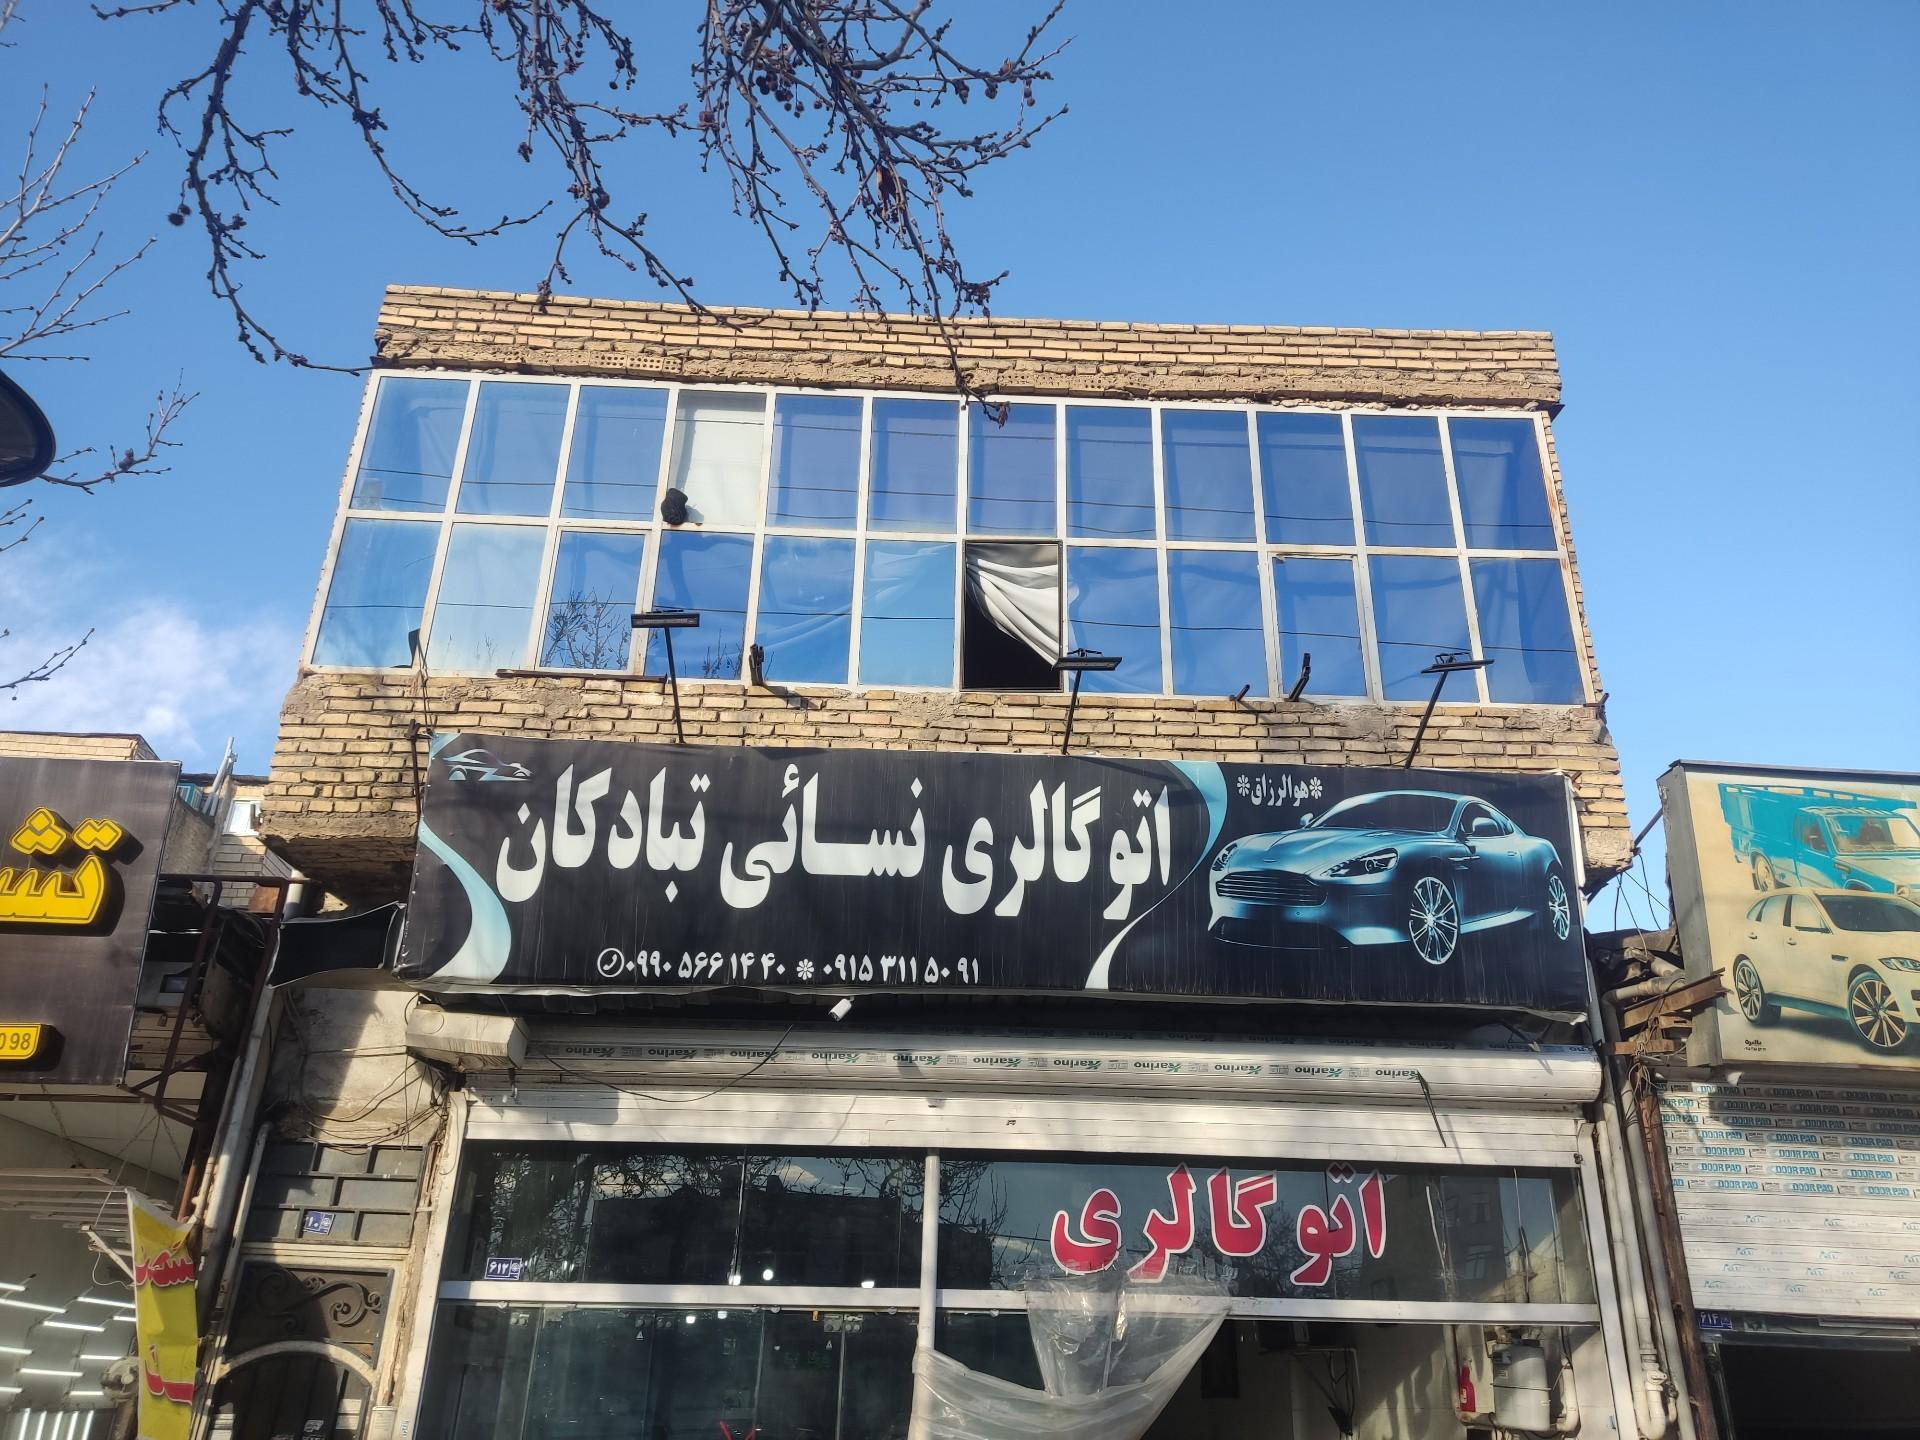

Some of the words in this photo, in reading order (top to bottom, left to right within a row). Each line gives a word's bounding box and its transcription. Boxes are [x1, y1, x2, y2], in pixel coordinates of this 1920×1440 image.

[496, 764, 711, 903] تبادکان
[720, 763, 925, 909] نسائی
[942, 779, 1101, 916] گالری
[1103, 785, 1171, 920] اتو
[1251, 773, 1309, 806] هوالرزاق
[1050, 1162, 1277, 1284] گالری
[1290, 1161, 1386, 1286] اتو
